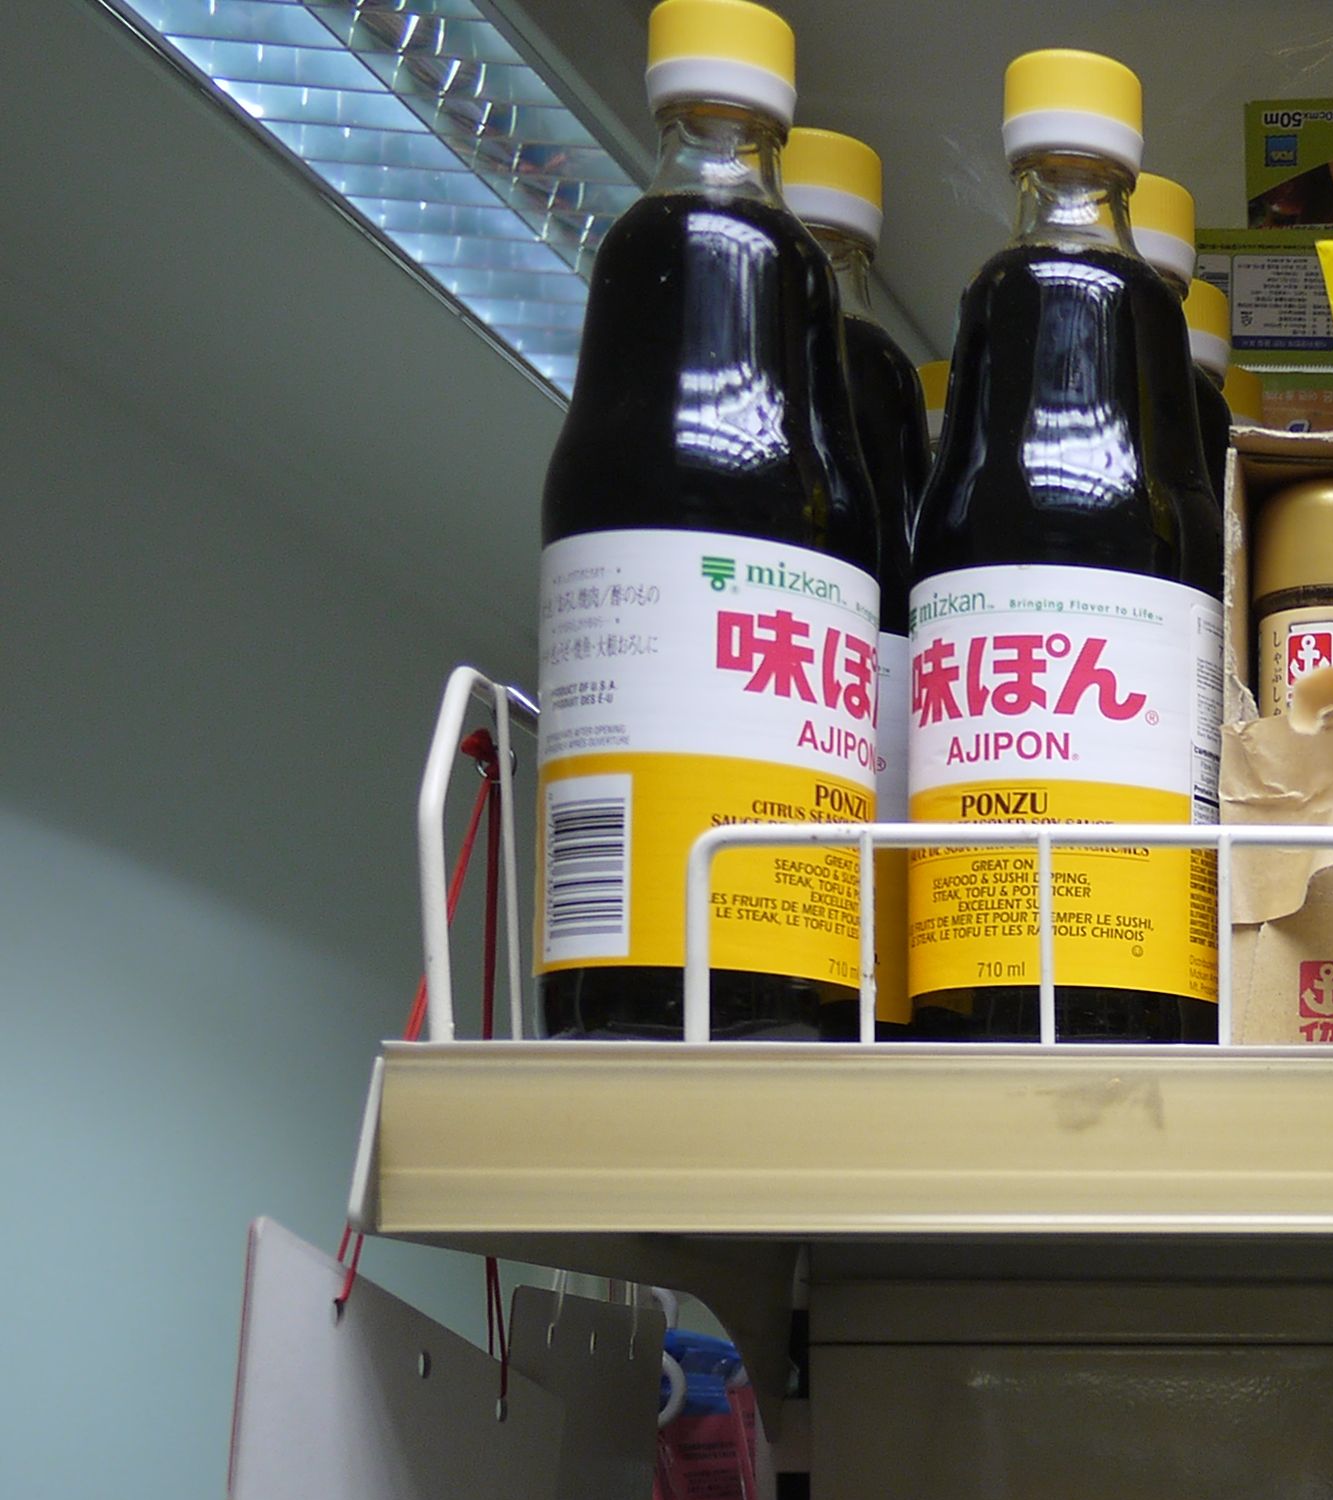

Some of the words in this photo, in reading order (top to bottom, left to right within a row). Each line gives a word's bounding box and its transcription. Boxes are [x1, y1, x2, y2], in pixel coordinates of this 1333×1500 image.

[746, 562, 840, 598] mizkan
[919, 592, 986, 624] mizkan
[1009, 599, 1063, 612] Bringing
[1070, 600, 1110, 613] Flavor
[1116, 605, 1128, 616] to
[1133, 607, 1154, 619] Life
[912, 633, 1146, 728] 味ぽん
[947, 731, 1070, 765] AJIPON
[961, 792, 1048, 817] PONZU
